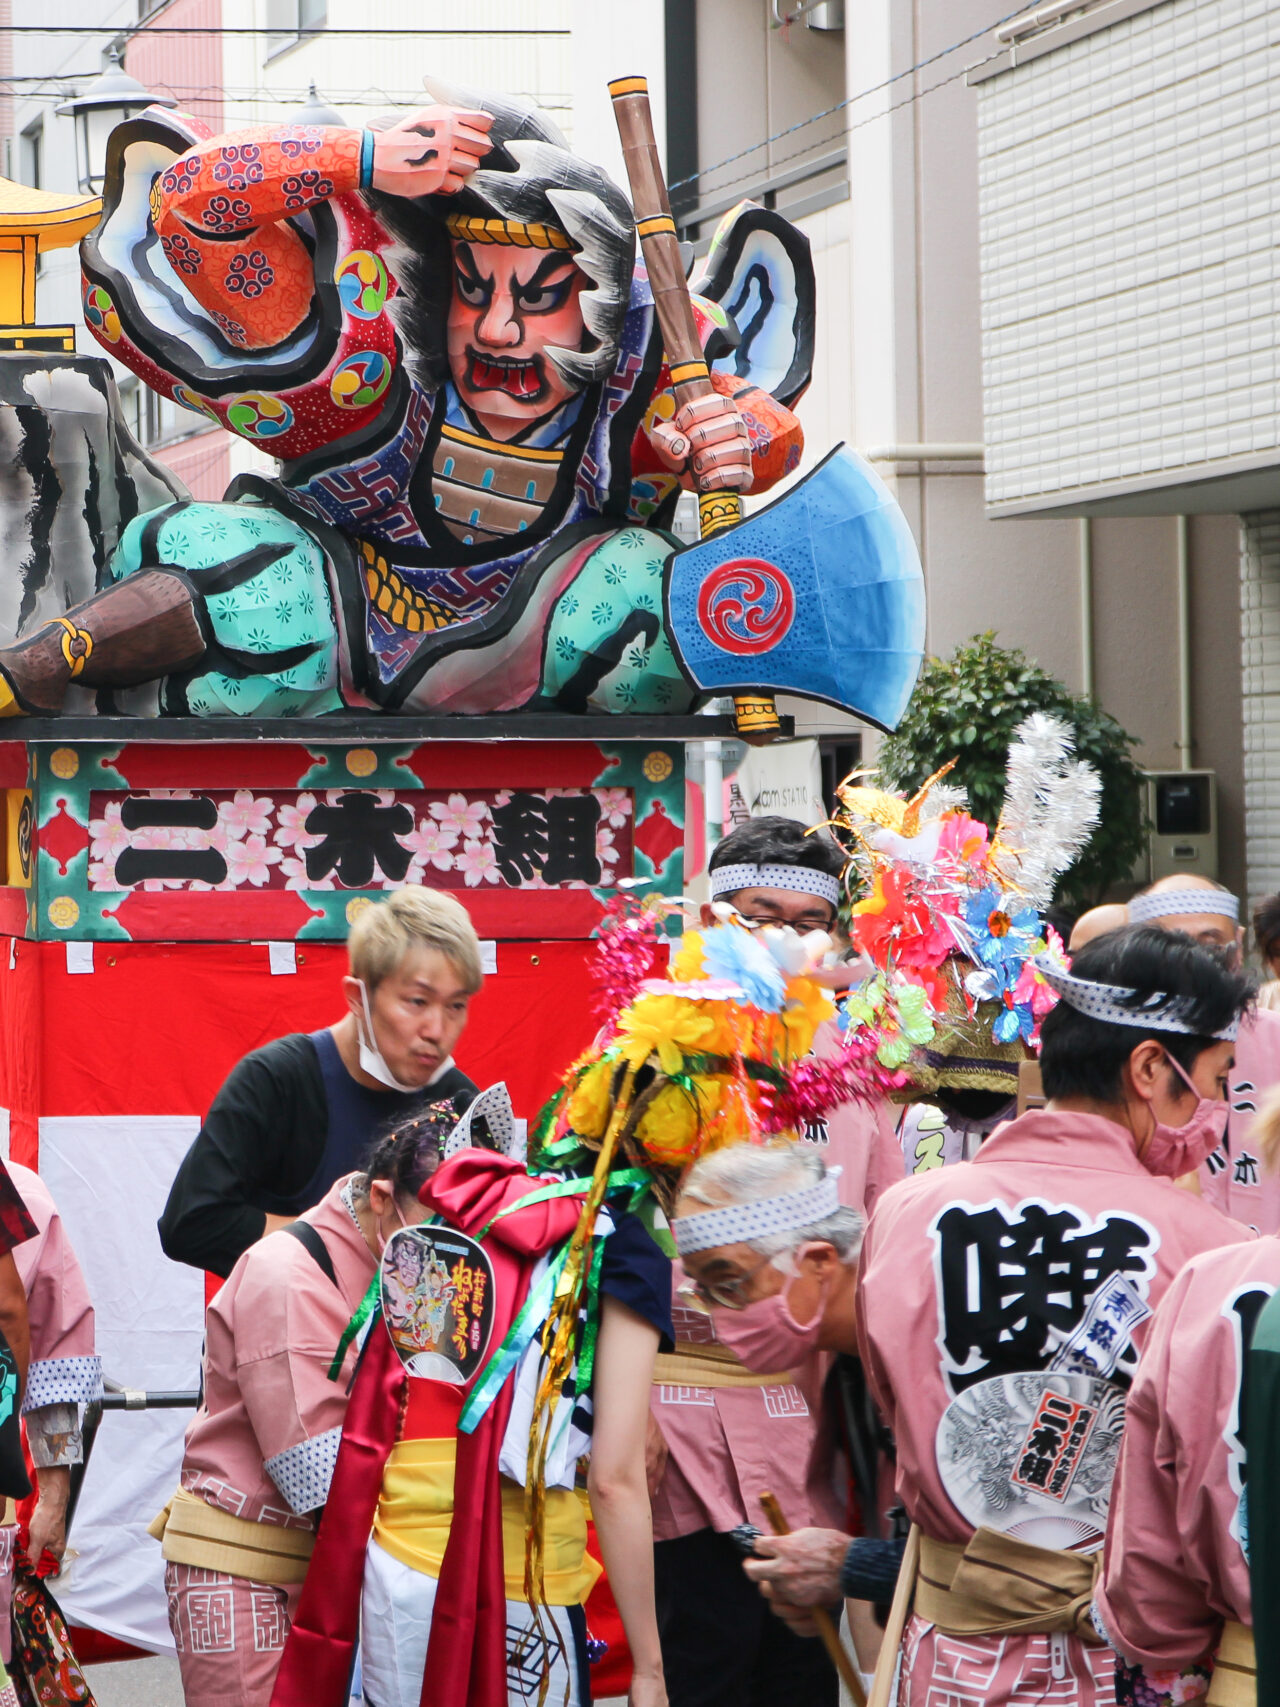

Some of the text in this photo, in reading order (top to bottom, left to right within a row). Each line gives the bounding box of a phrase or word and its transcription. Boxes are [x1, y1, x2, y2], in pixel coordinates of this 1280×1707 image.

[115, 792, 602, 888] 二木組
[1019, 1397, 1075, 1489] 二木組
